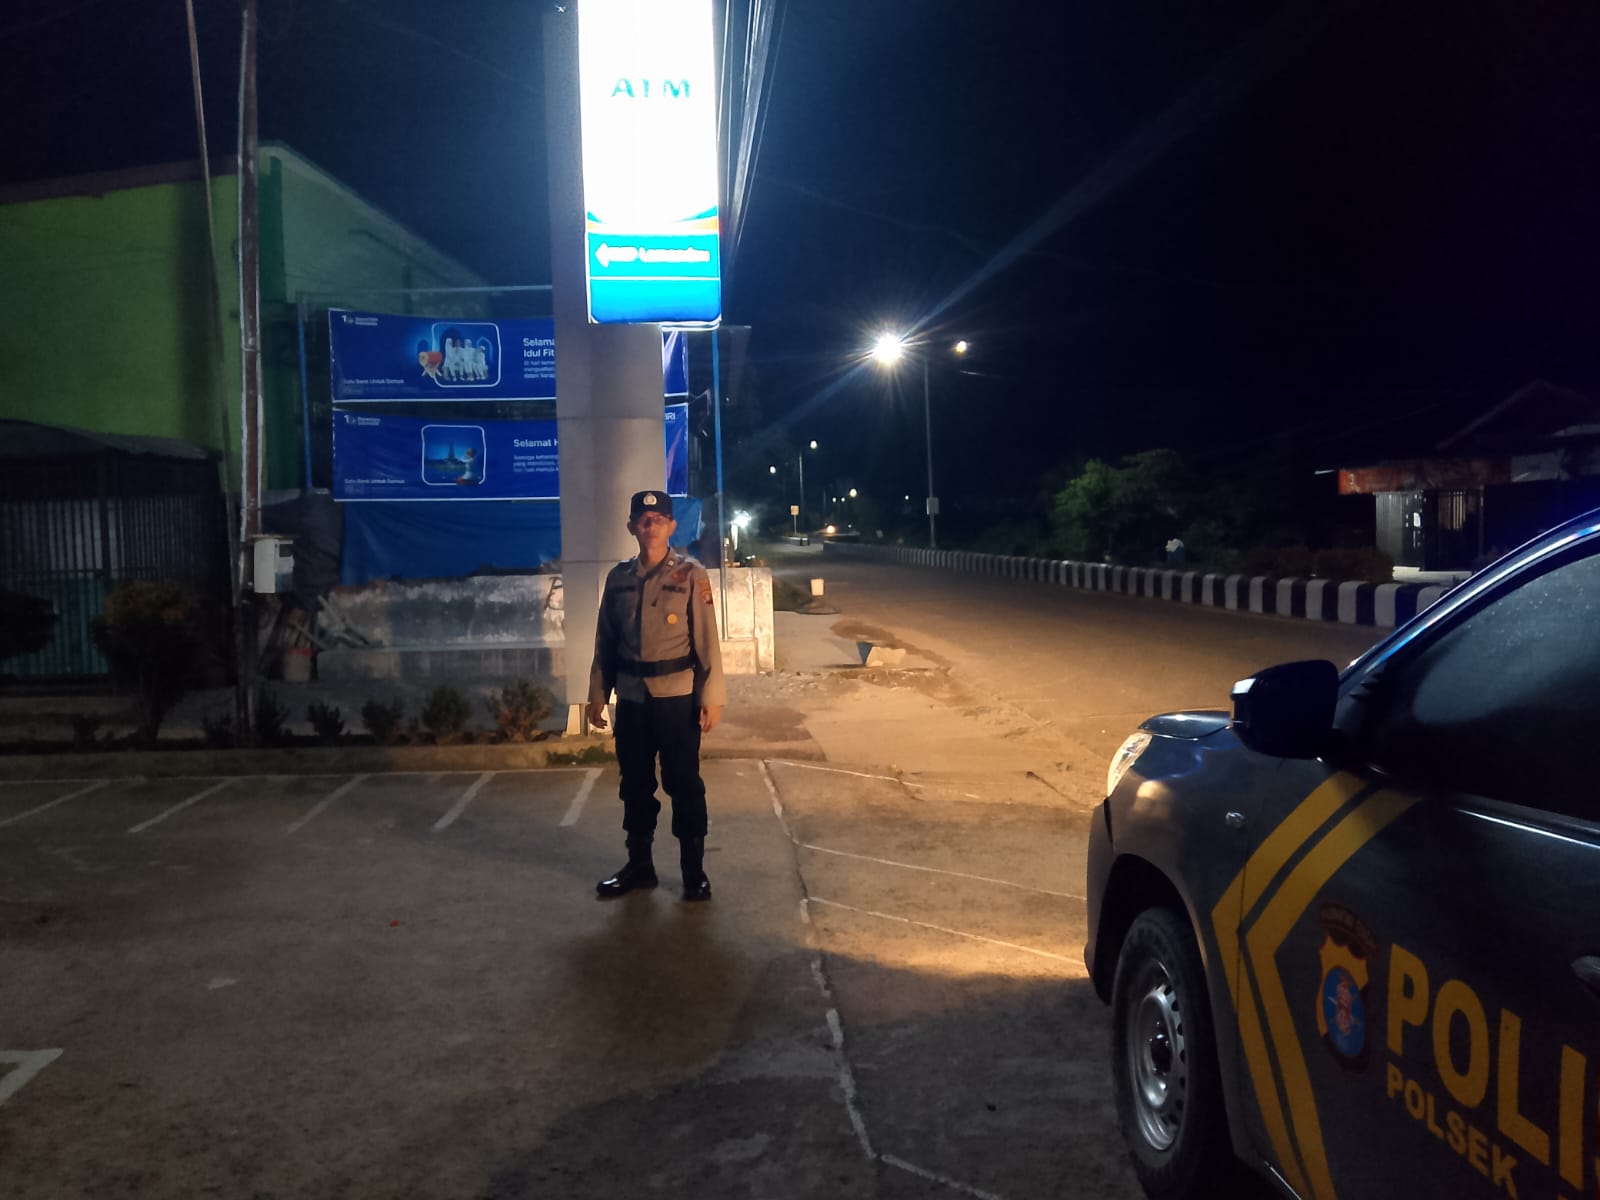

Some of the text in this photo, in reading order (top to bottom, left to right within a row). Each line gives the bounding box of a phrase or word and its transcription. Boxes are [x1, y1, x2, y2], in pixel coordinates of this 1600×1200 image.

[523, 349, 541, 357] Idul
[513, 438, 552, 448] Selamat
[1387, 942, 1600, 1195] POLI
[1387, 1060, 1517, 1200] POLSEK
